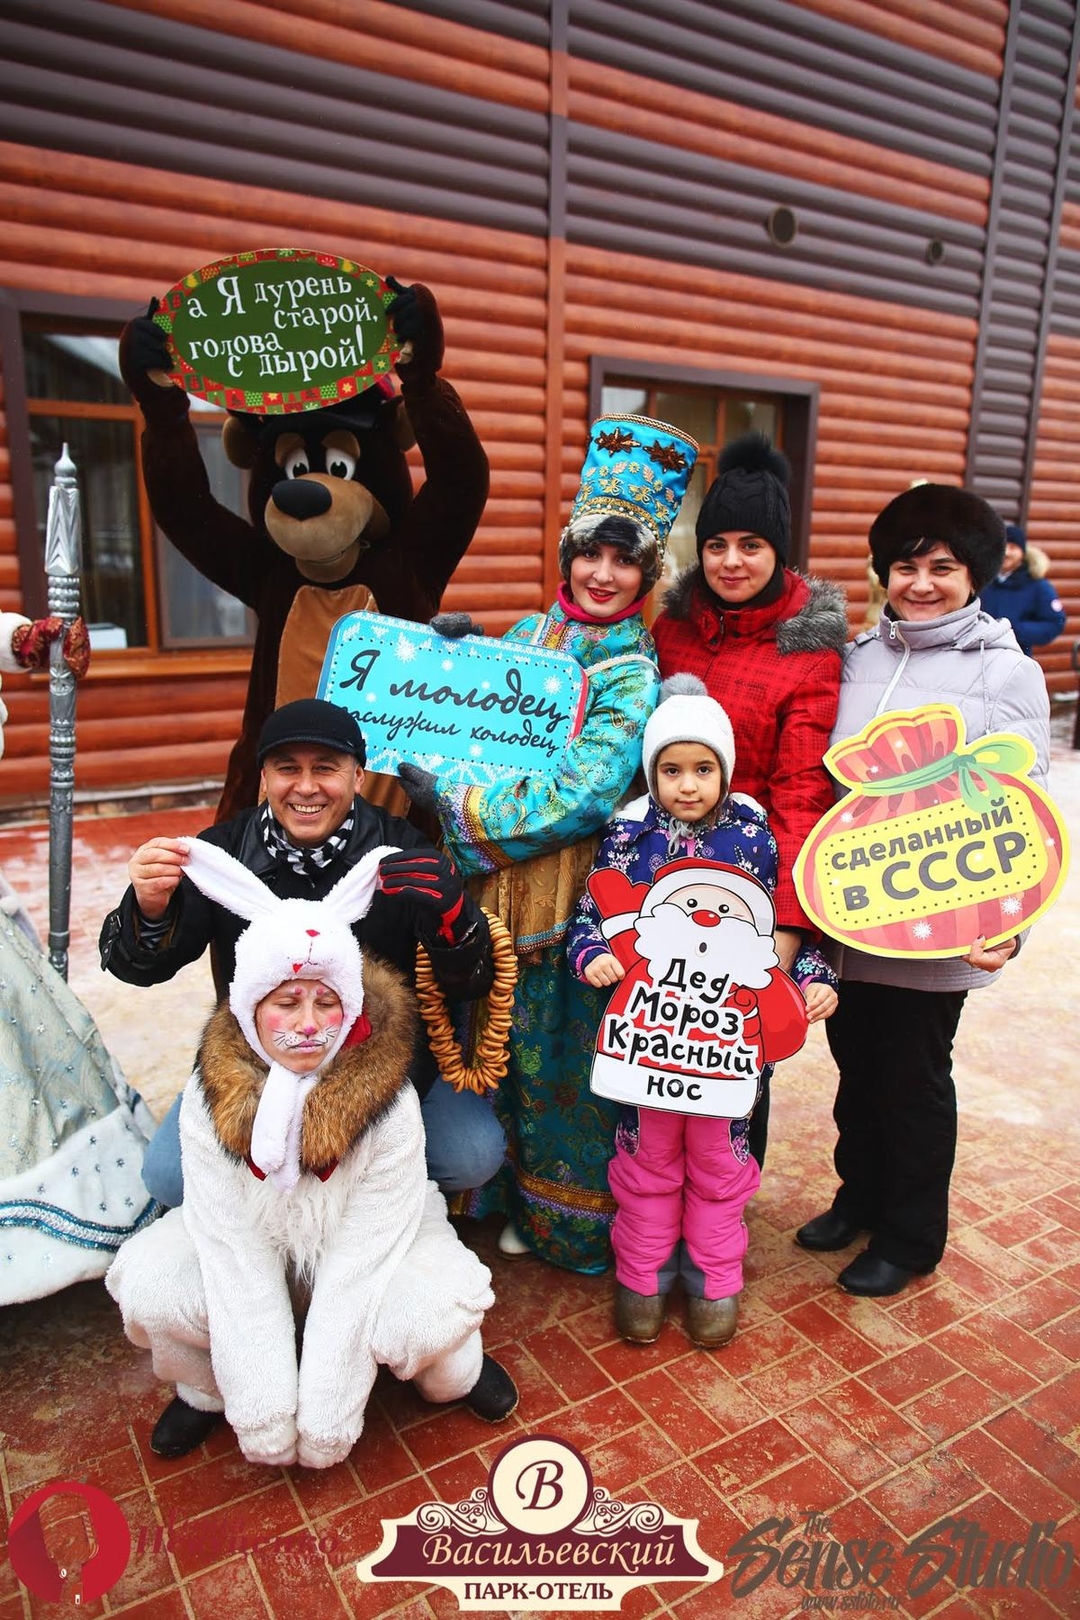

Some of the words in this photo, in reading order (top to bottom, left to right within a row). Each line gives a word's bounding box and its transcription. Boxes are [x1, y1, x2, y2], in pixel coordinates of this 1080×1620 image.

[187, 297, 208, 319] а
[217, 275, 246, 316] Я
[254, 274, 353, 309] дурень
[273, 296, 379, 335] старой,
[188, 331, 284, 360] голова
[258, 323, 367, 383] дырой!
[339, 649, 381, 691] Я
[389, 667, 570, 732] молодец
[342, 705, 462, 742] аслужил
[470, 718, 560, 757] холодец
[830, 796, 1014, 872] сделанный
[880, 830, 1027, 901] СССР
[657, 957, 730, 1004] Дед
[629, 986, 739, 1036] Мороз
[607, 1018, 754, 1075] Красный
[646, 1075, 702, 1101] нос
